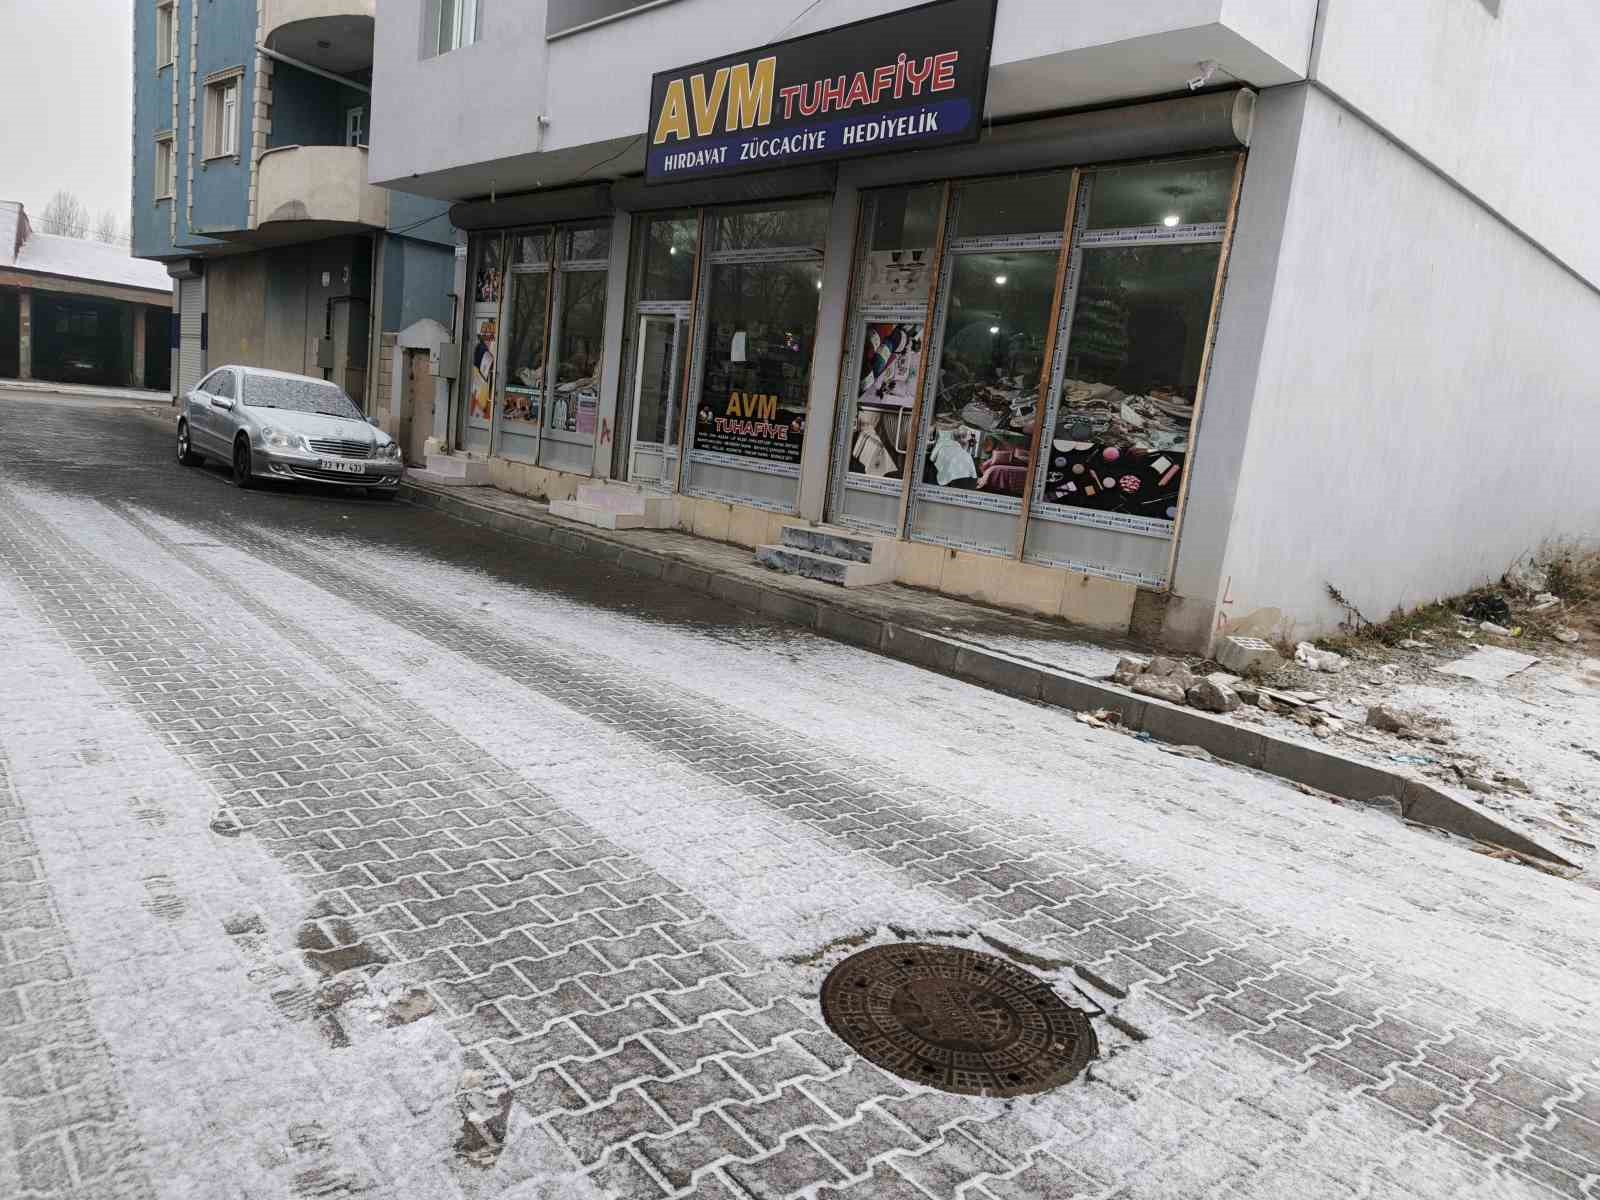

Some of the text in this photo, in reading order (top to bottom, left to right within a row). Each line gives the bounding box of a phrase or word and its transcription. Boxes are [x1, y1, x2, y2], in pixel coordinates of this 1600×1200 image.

[653, 51, 959, 145] AVM TUHAFİYE
[664, 108, 938, 172] HIRDAVAT ZÜCCACİYE HEDİYELİK
[726, 391, 777, 420] AVM
